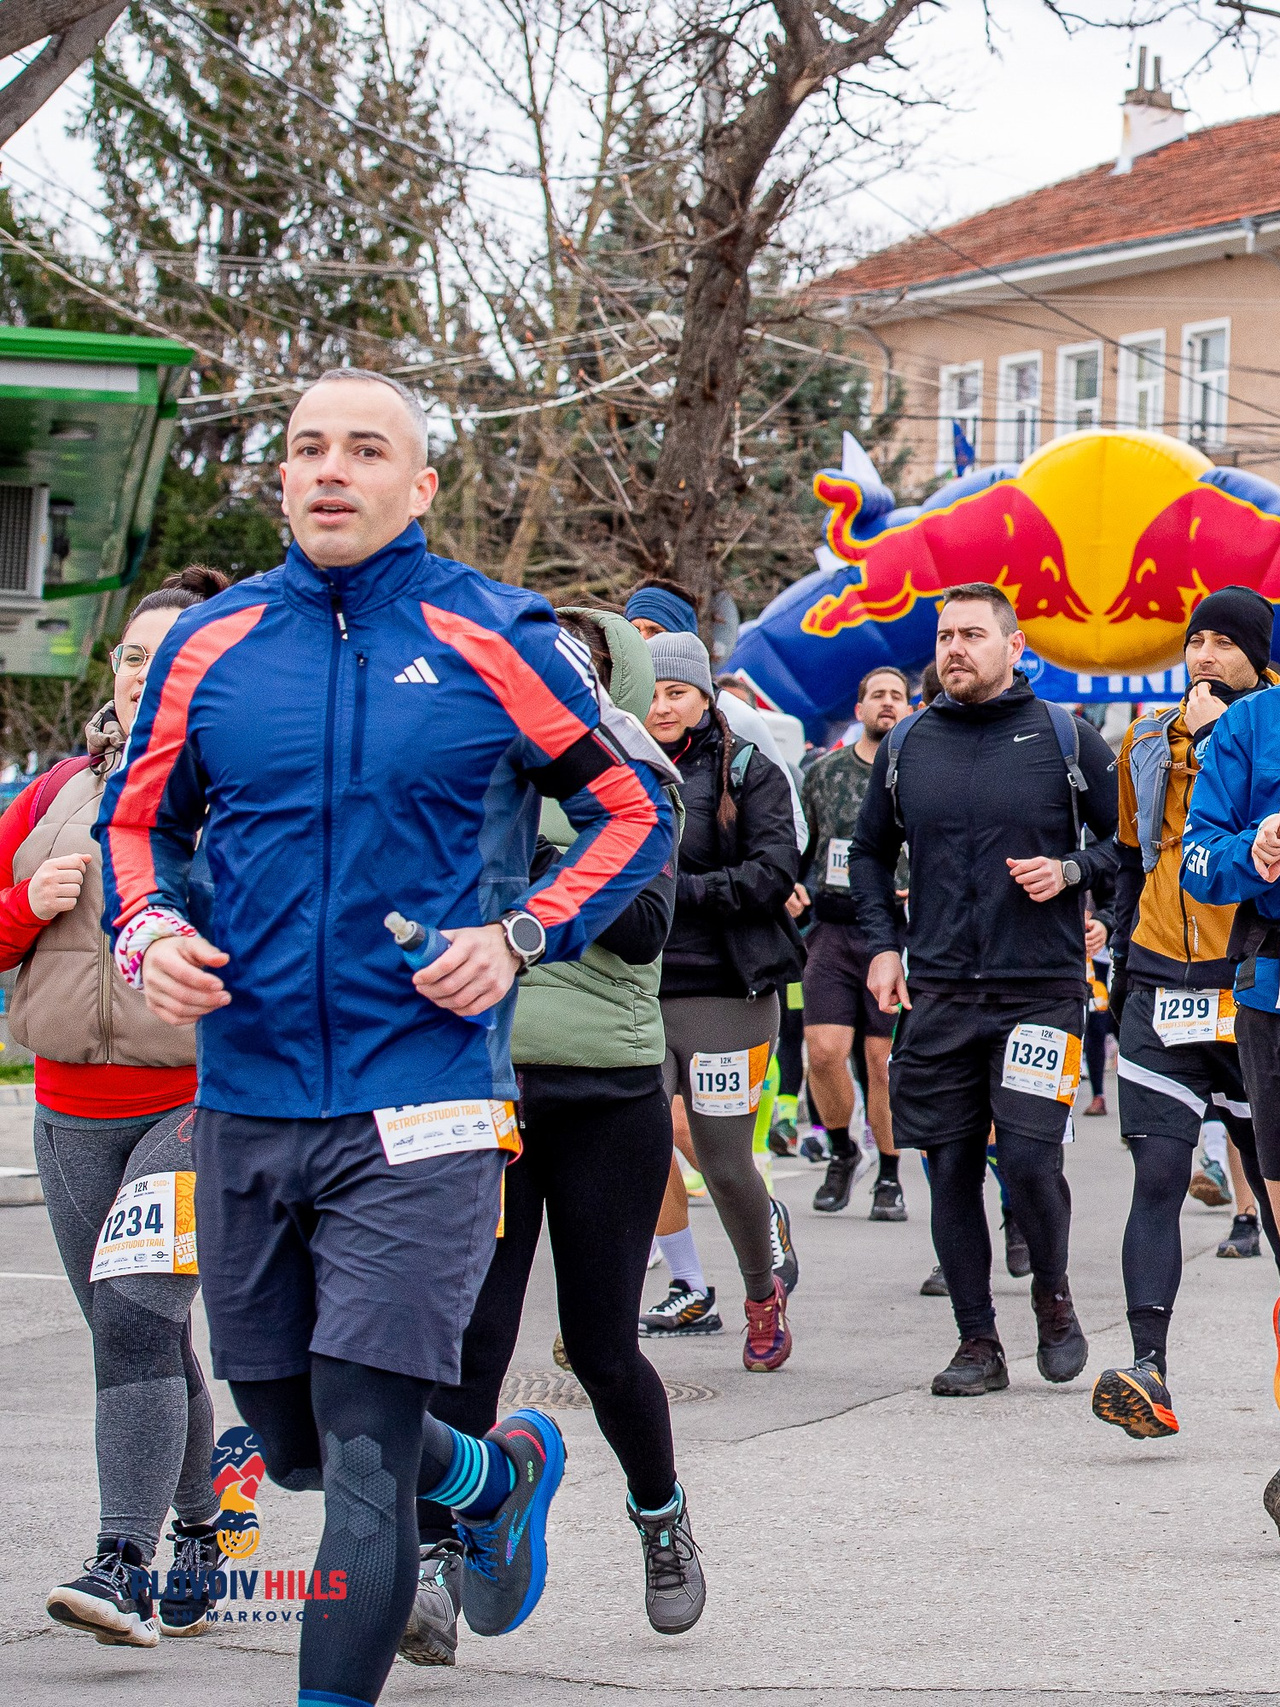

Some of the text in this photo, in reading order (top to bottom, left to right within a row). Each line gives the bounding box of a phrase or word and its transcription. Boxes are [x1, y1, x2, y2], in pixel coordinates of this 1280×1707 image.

[1160, 997, 1210, 1021] 1299
[1041, 1029, 1054, 1039] 12K
[1011, 1041, 1059, 1071] 1329
[696, 1071, 740, 1093] 1193
[461, 1103, 483, 1116] TRAIL
[134, 1180, 149, 1193] 12K
[103, 1203, 164, 1243] 1234
[146, 1238, 165, 1248] TRAIL
